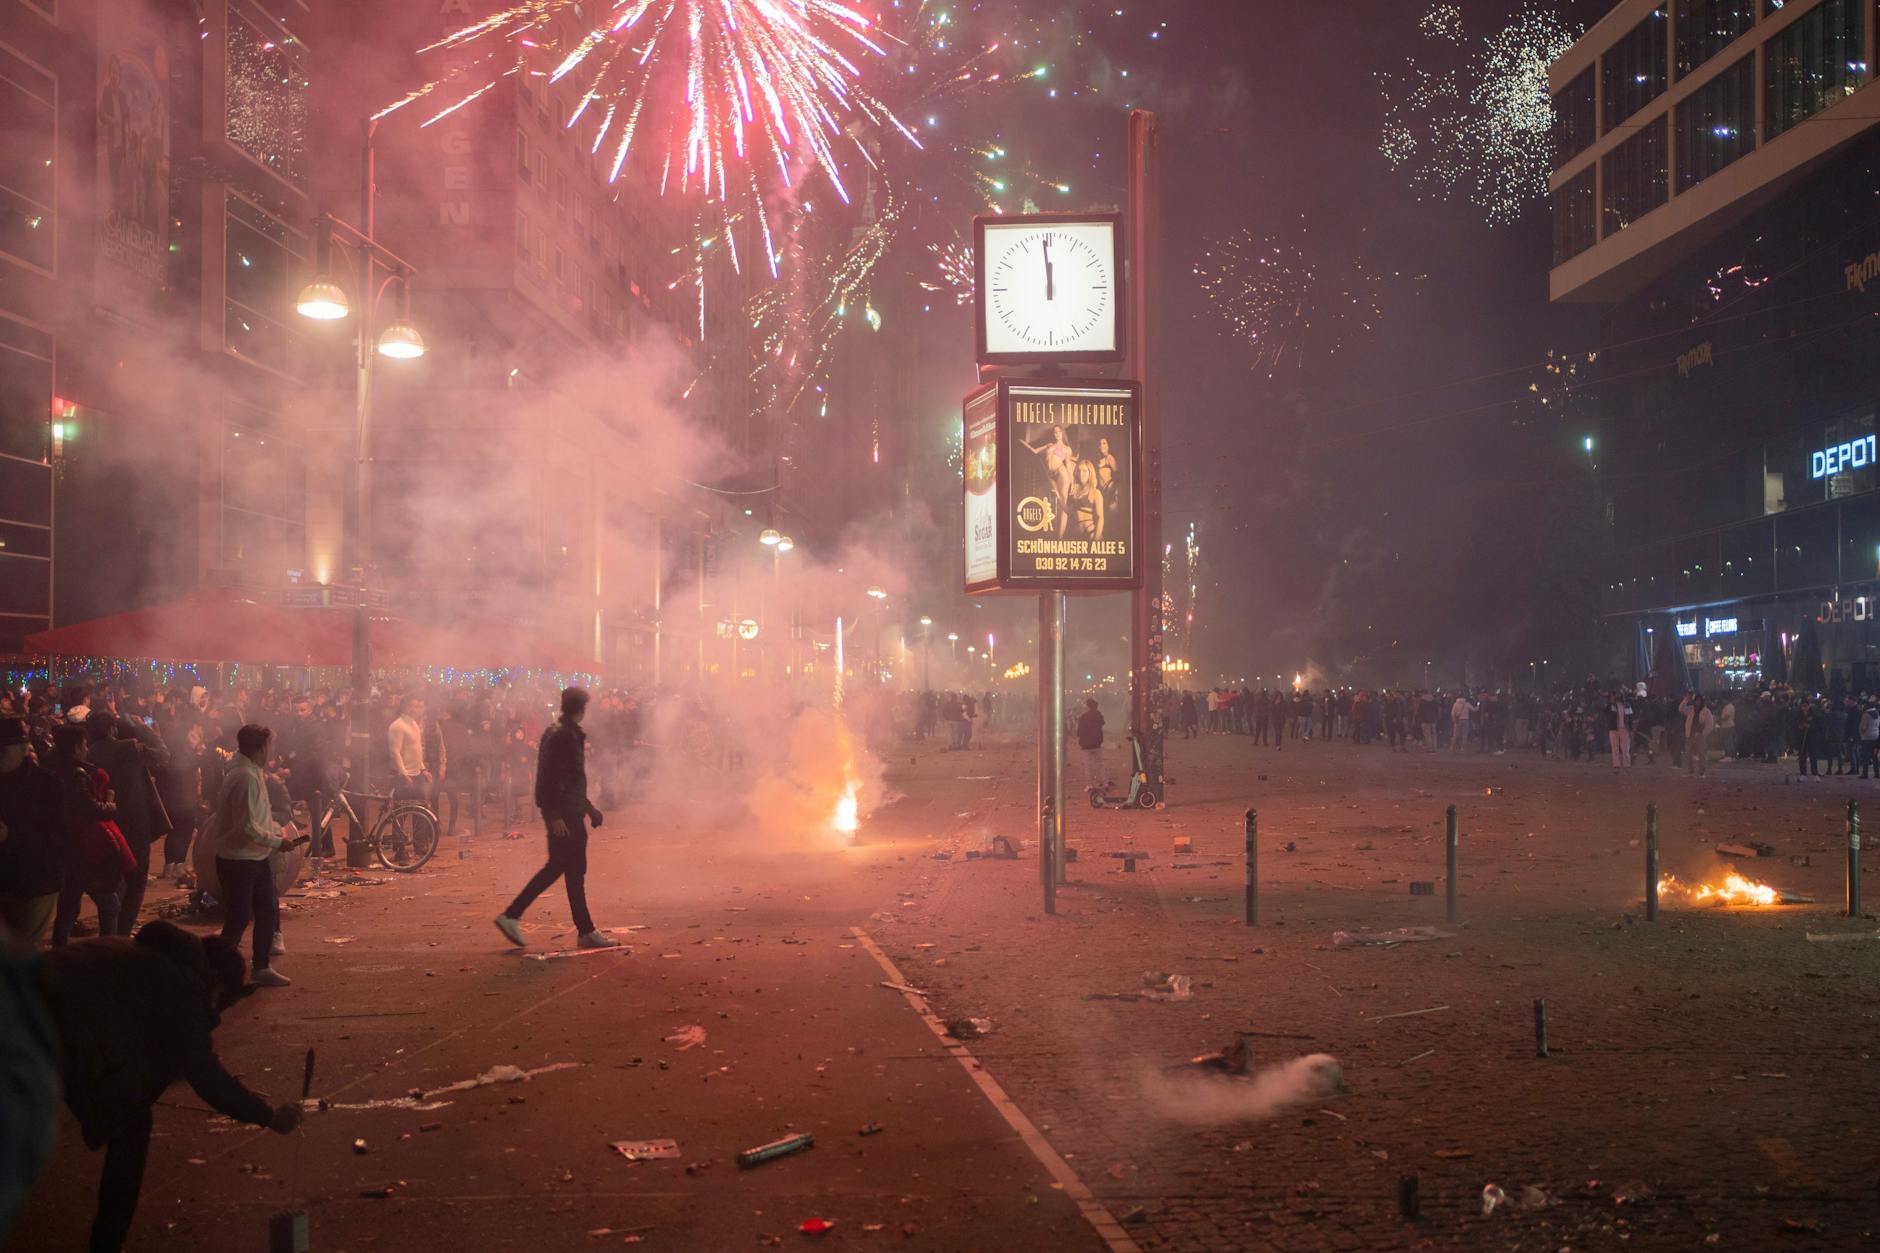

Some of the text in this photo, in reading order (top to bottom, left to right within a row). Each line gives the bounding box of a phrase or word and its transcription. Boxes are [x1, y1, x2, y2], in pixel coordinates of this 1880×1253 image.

[1016, 402, 1054, 424] ANGELS
[1061, 403, 1124, 426] TABLEDANCE
[1812, 434, 1876, 479] DEPOT
[1023, 507, 1042, 521] ANGELS
[1017, 538, 1126, 555] SCHÖNHAUSER ALLEE 5
[1035, 557, 1107, 571] 030 92 14 76 23
[1821, 595, 1876, 623] DEPOT
